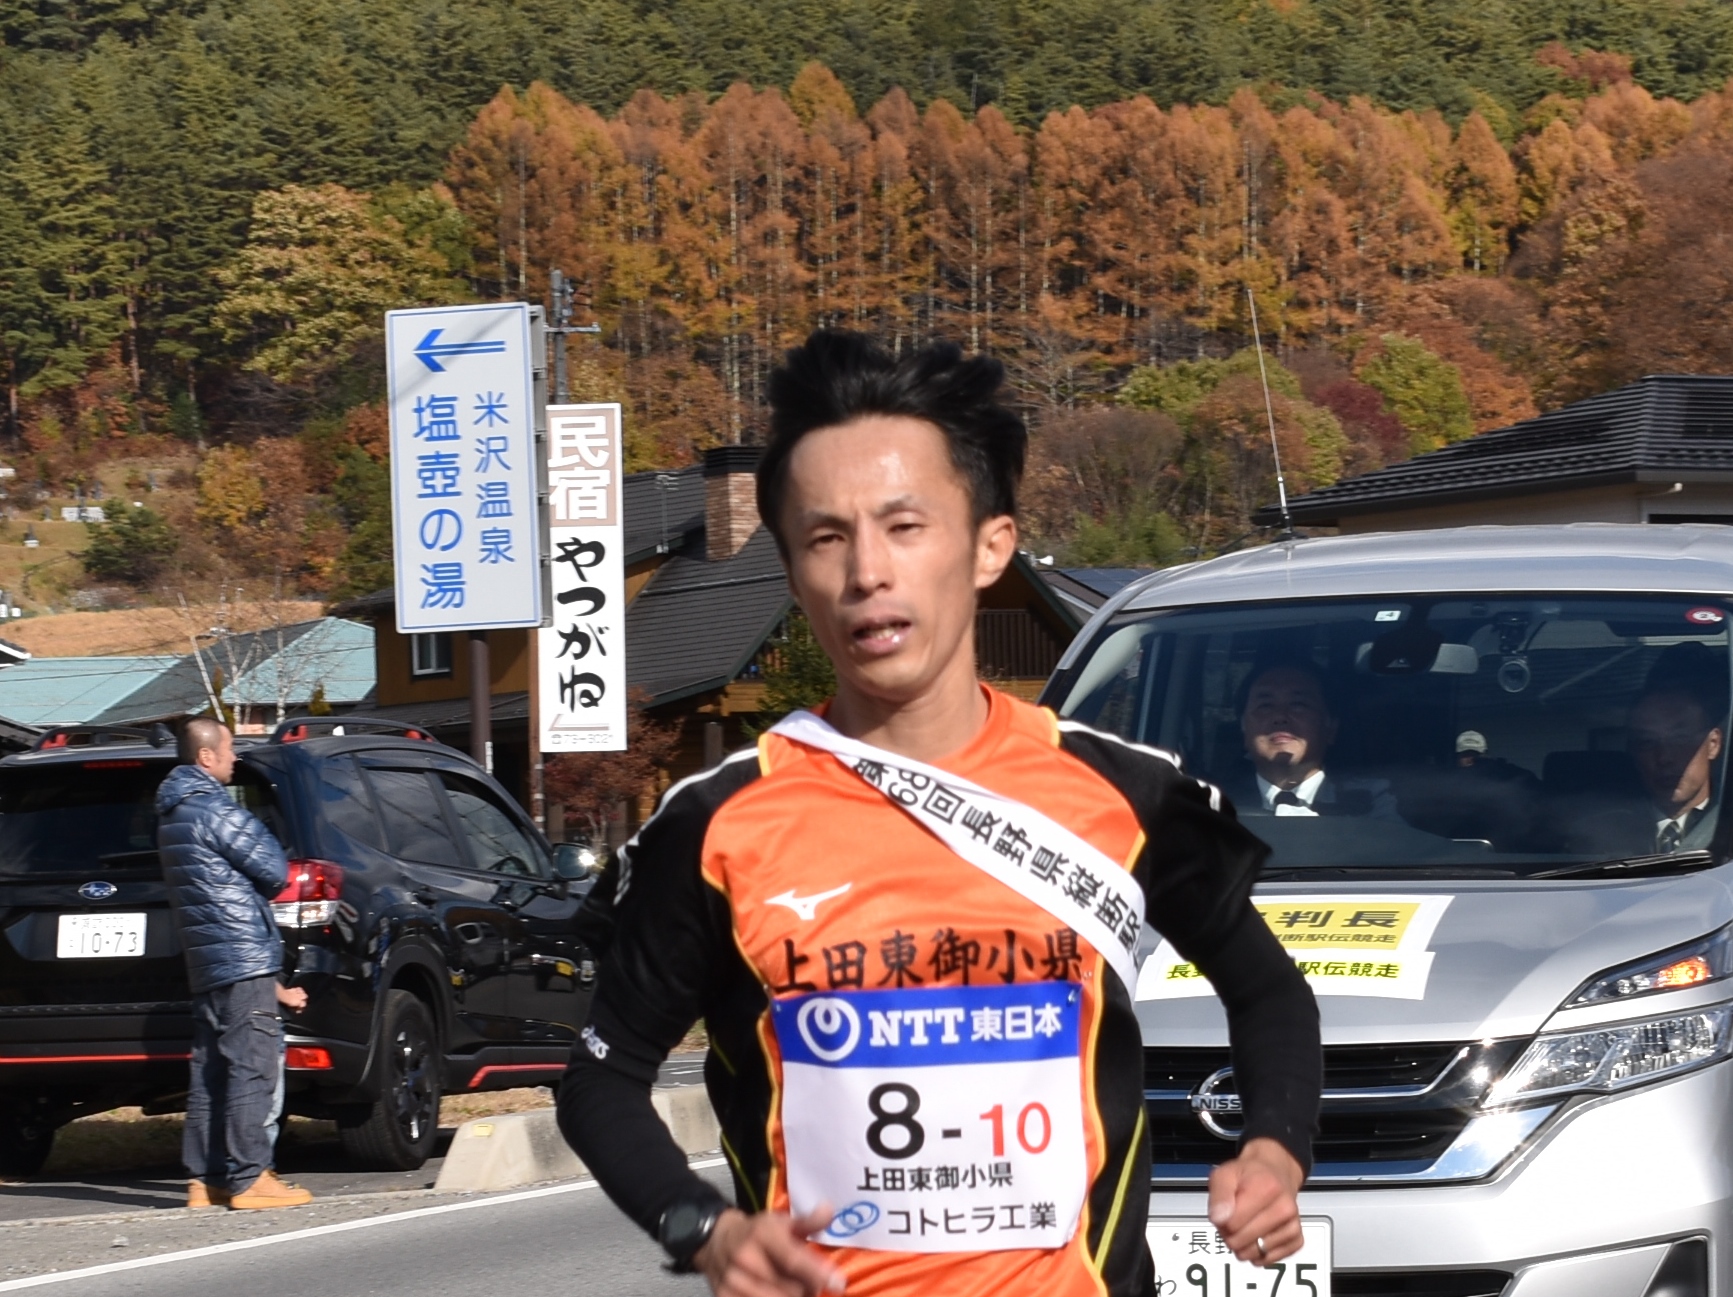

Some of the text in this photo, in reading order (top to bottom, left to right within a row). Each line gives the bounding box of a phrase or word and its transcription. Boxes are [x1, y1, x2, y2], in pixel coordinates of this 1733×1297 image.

[473, 391, 515, 563] 米沢温泉
[548, 414, 610, 521] 民宿
[412, 394, 466, 608] 塩壺の湯
[853, 757, 1140, 962] 第68回長野県縦断駅
[1260, 910, 1400, 928] 判長
[1277, 933, 1397, 943] 断駅伝競走
[774, 927, 1083, 993] 上田東御小県
[868, 1003, 1062, 1047] NTT 東日本
[866, 1082, 1051, 1160] 8-10
[1201, 1098, 1240, 1109] NISS
[857, 1162, 1013, 1192] 上田東御小県
[887, 1202, 1057, 1237] コトヒラ工業
